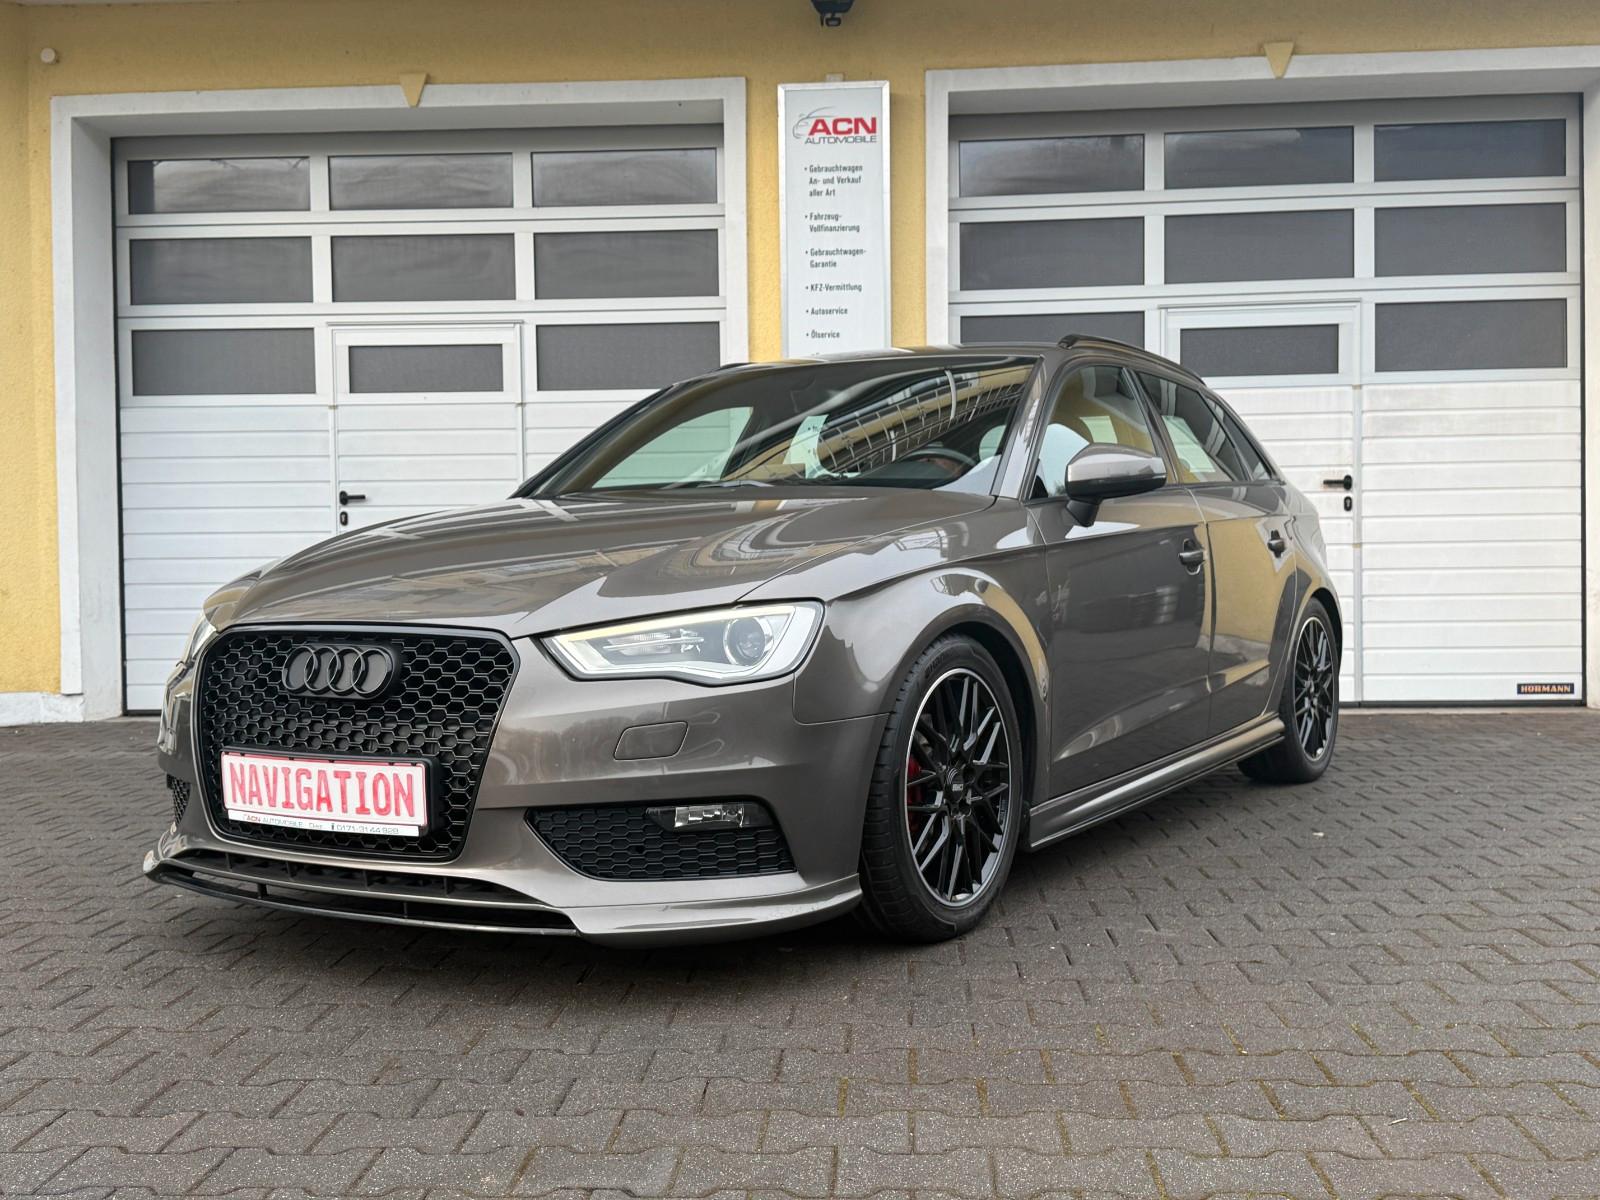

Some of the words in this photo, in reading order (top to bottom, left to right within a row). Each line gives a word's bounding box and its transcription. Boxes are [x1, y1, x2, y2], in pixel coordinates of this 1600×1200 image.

[808, 117, 877, 136] ACN
[804, 136, 877, 145] AUTOMOBILE
[809, 164, 863, 174] Gebrauchtwagen
[809, 177, 820, 185] An-
[822, 176, 834, 184] und
[836, 175, 861, 184] Verkauf
[809, 189, 823, 197] aller
[825, 188, 836, 197] Art
[809, 212, 842, 222] Fahrzeug-
[809, 224, 860, 233] Vollfinanzierung
[810, 248, 866, 257] Gebrauchtwagen-
[810, 260, 837, 268] Garantie
[811, 283, 862, 292] KFZ-Vermittlung
[811, 307, 848, 315] Autoservice
[811, 329, 840, 338] Ölservice
[229, 762, 415, 818] NAVIGATION
[262, 817, 303, 828] AUTOMOBILE
